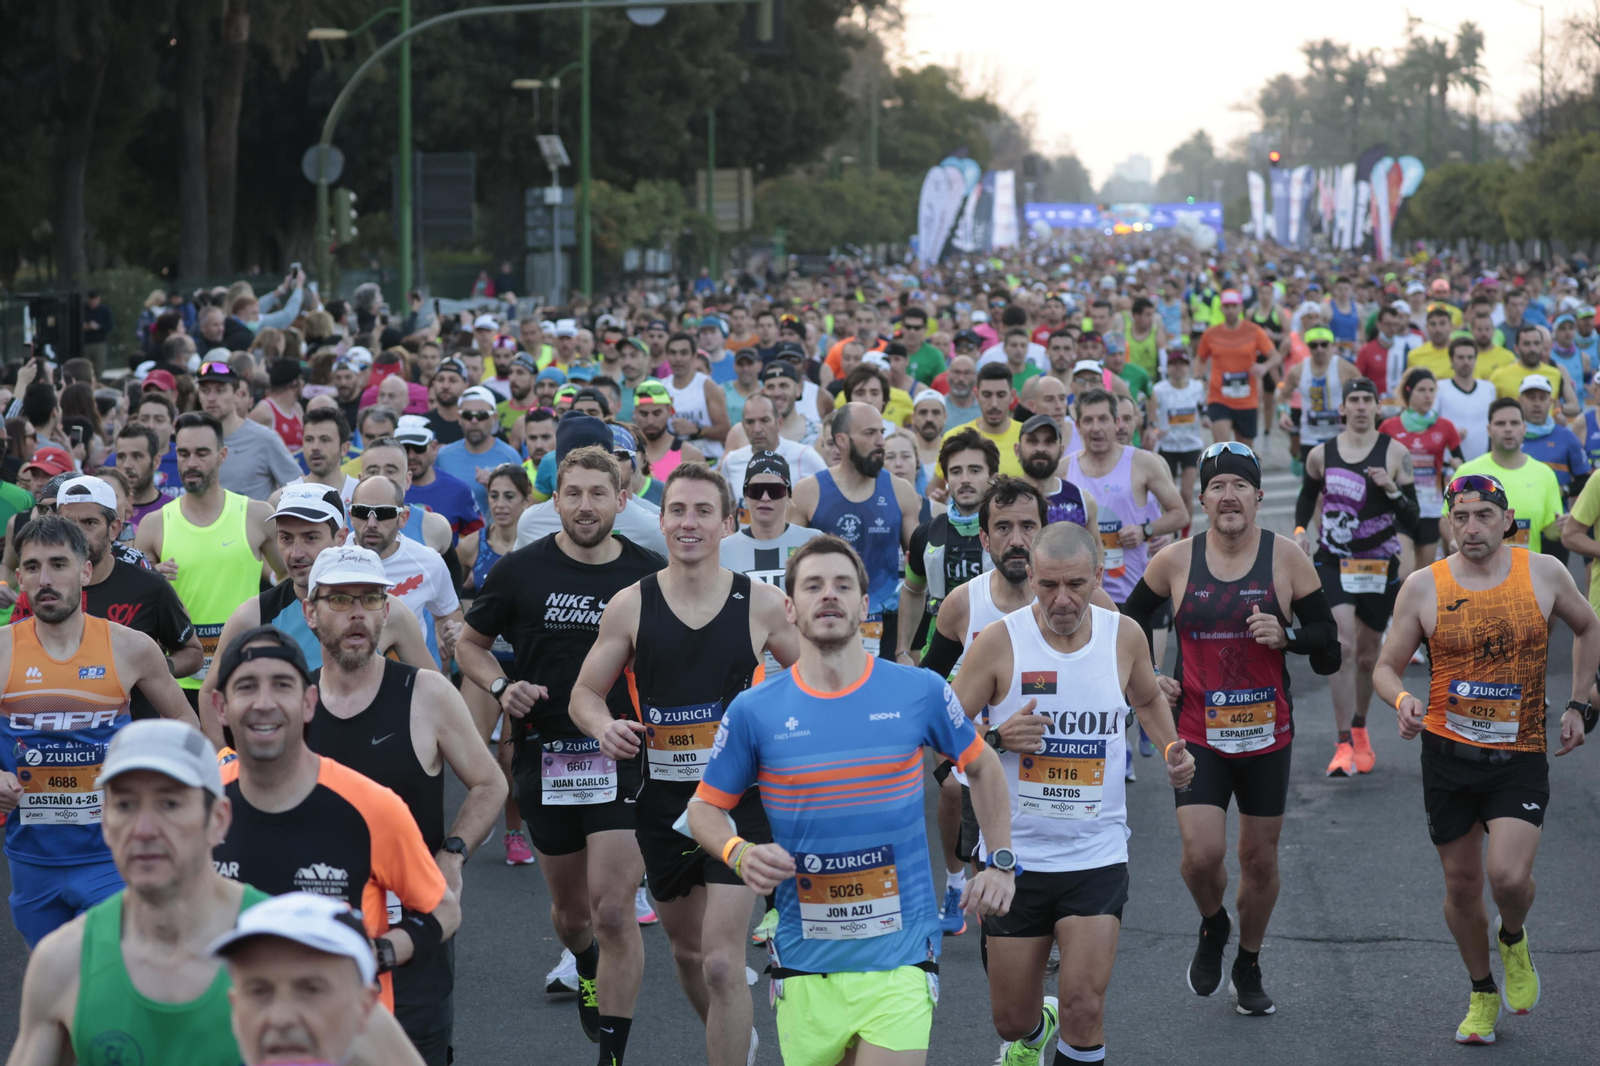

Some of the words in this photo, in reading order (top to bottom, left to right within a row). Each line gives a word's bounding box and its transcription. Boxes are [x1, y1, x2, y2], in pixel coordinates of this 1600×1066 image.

[545, 592, 595, 609] NIKE
[1472, 686, 1514, 696] ZURICH
[1229, 692, 1268, 703] ZURICH
[664, 708, 712, 722] ZURICH
[1470, 705, 1496, 718] 4212
[10, 710, 118, 731] CAPA
[1030, 711, 1118, 735] NGOLA
[1230, 713, 1254, 723] 4422
[1472, 720, 1491, 729] KICO
[789, 730, 811, 739] FARMA
[1220, 726, 1264, 738] ESPARTANO
[668, 734, 695, 746] 4881
[1049, 743, 1097, 754] ZURICH
[46, 752, 96, 764] ZURICH
[672, 753, 697, 762] ANTO
[567, 760, 594, 772] 6607
[1048, 767, 1078, 780] 5116
[48, 776, 78, 788] 4688
[552, 778, 574, 788] JUAN
[576, 776, 610, 787] CARLOS
[1042, 786, 1080, 798] BASTOS
[28, 794, 73, 806] CASTAÑO
[76, 794, 98, 804] 4-26
[825, 852, 883, 870] ZURICH
[830, 883, 864, 898] 5026
[826, 907, 848, 918] JON
[851, 904, 873, 917] AZU
